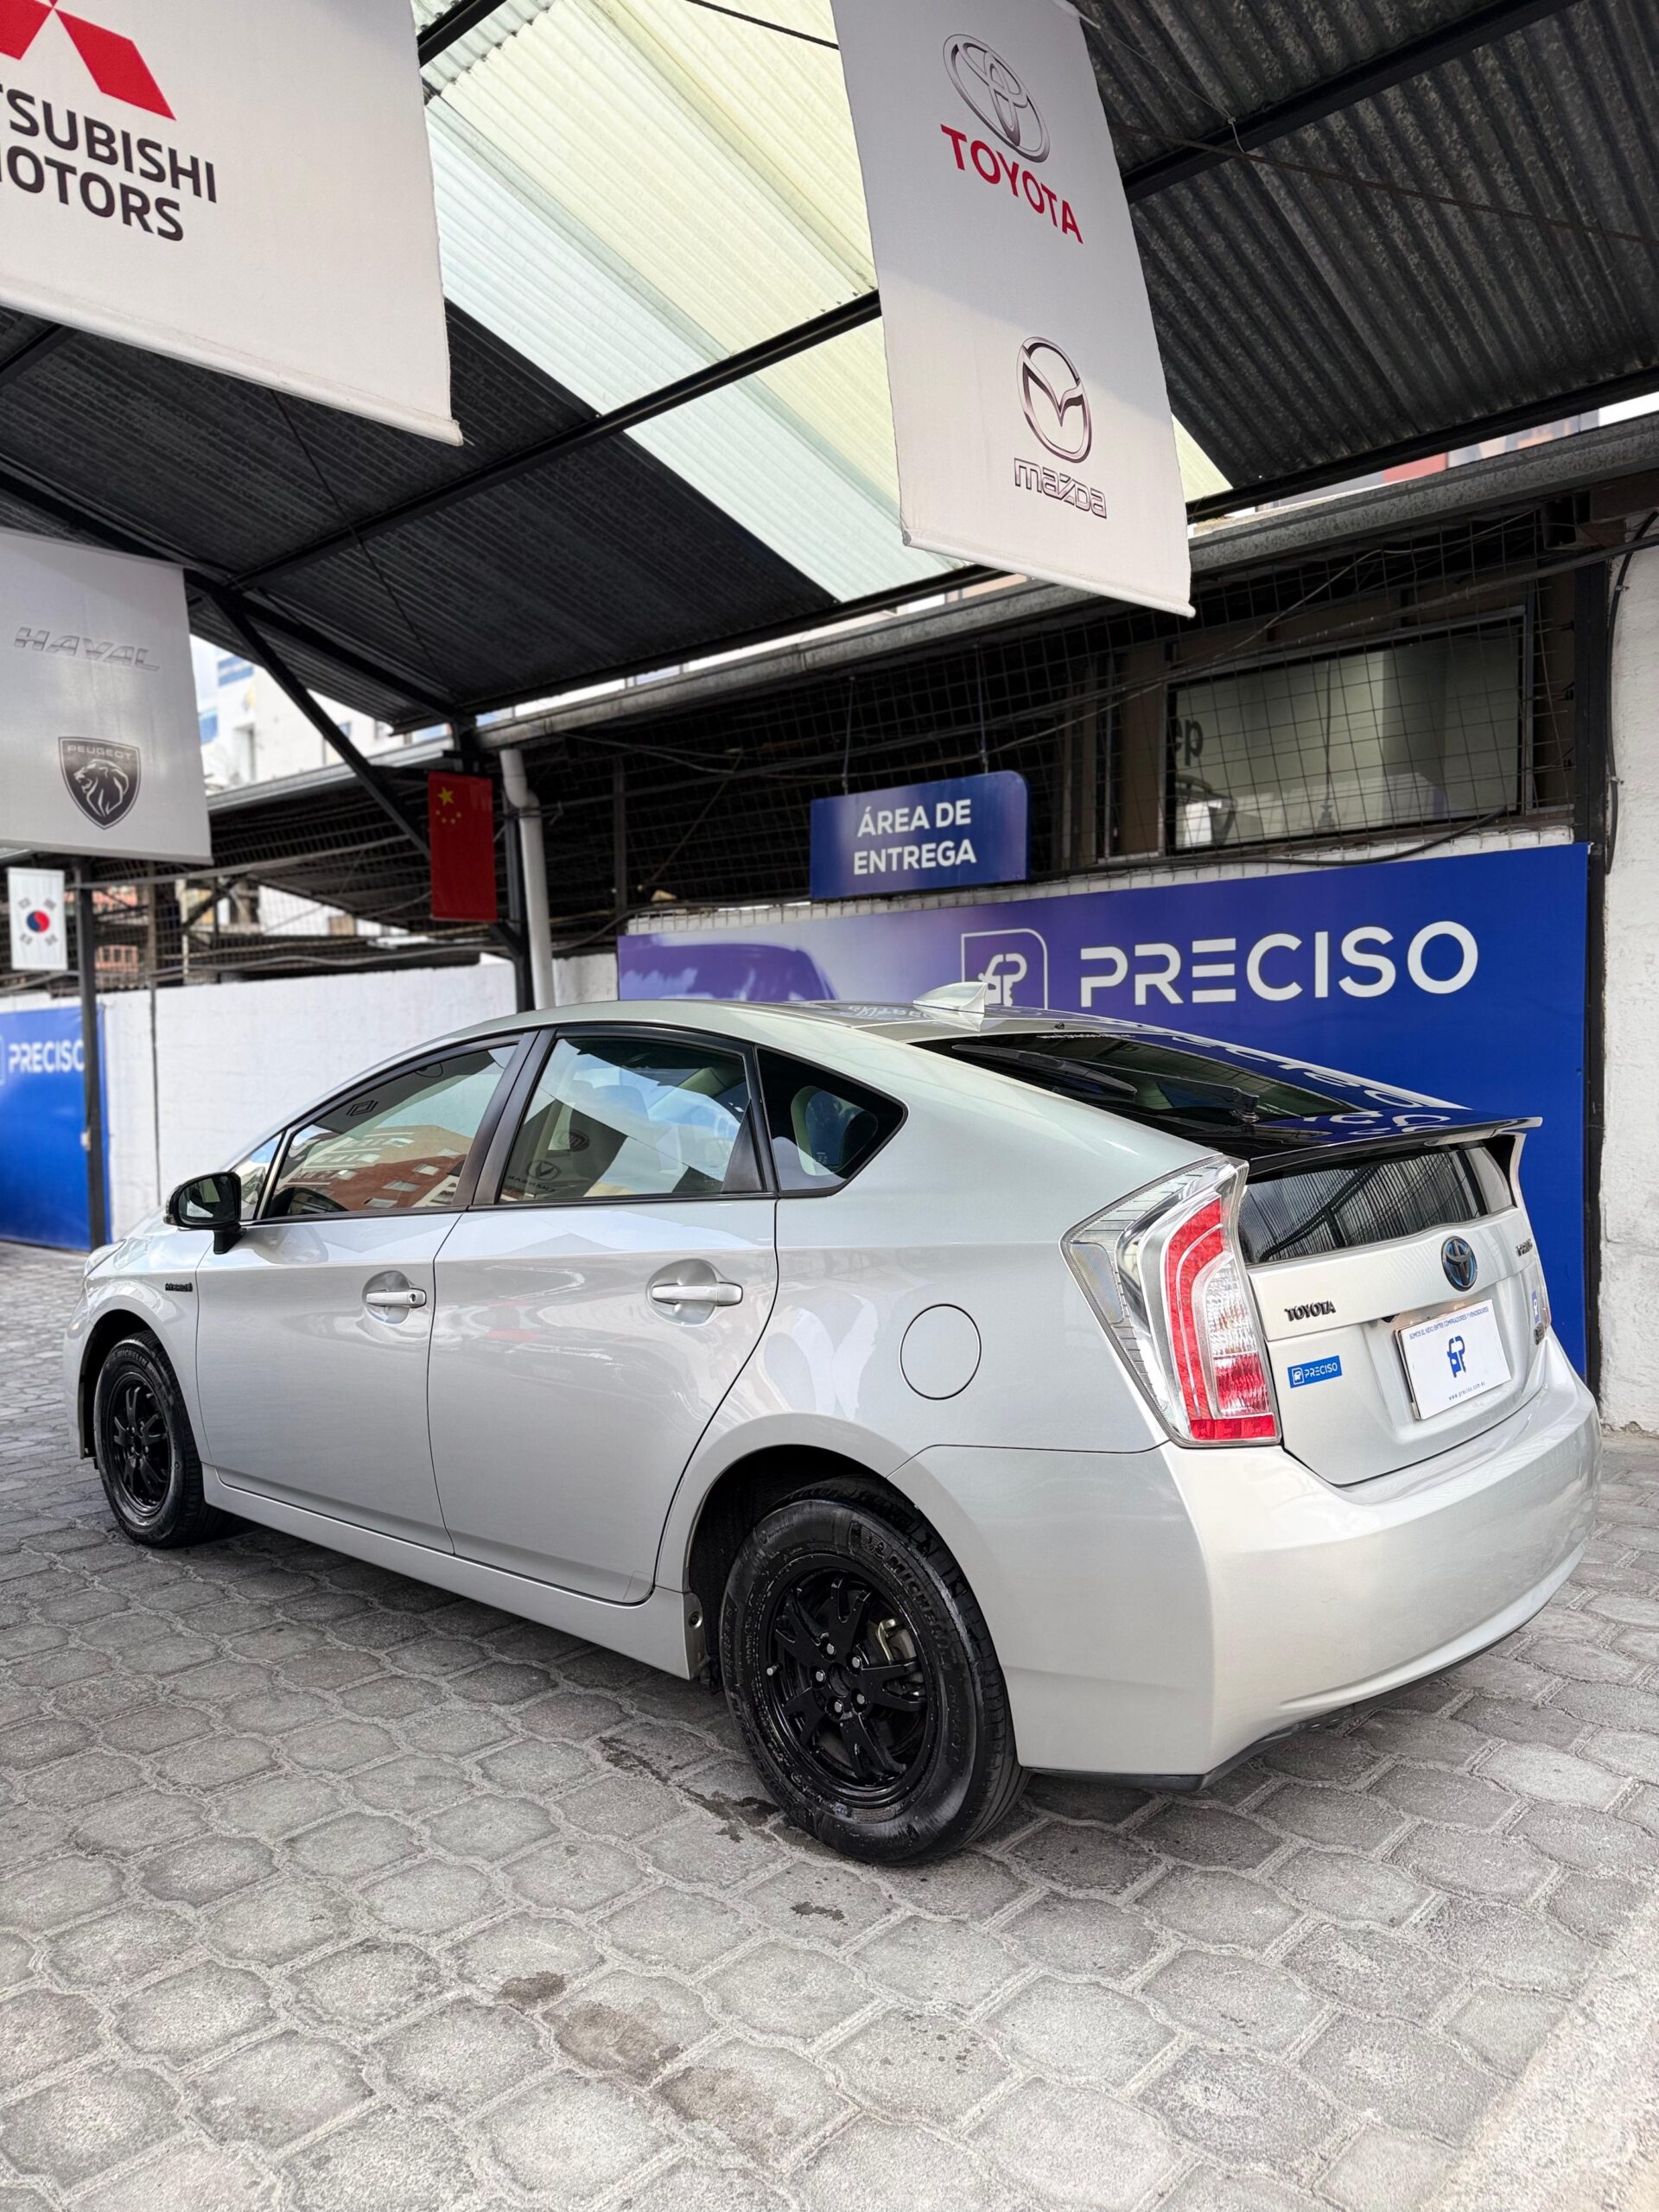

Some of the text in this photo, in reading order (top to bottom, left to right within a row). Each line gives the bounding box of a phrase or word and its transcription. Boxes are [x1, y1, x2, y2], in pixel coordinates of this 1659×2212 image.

[0, 84, 217, 203] SUBISHI
[0, 145, 184, 241] OTORS
[941, 124, 1084, 244] TOYOTA
[1014, 457, 1107, 519] mazda
[14, 626, 161, 671] HAVAL
[67, 745, 131, 760] PEUGEOT
[857, 798, 971, 837] ÁREA DE
[854, 839, 976, 875] ENTREGA
[1081, 920, 1478, 1007] PRECISO
[1284, 1300, 1336, 1321] TOYOTA
[116, 1349, 148, 1368] MICHELIN
[1305, 1363, 1338, 1378] PRECISO
